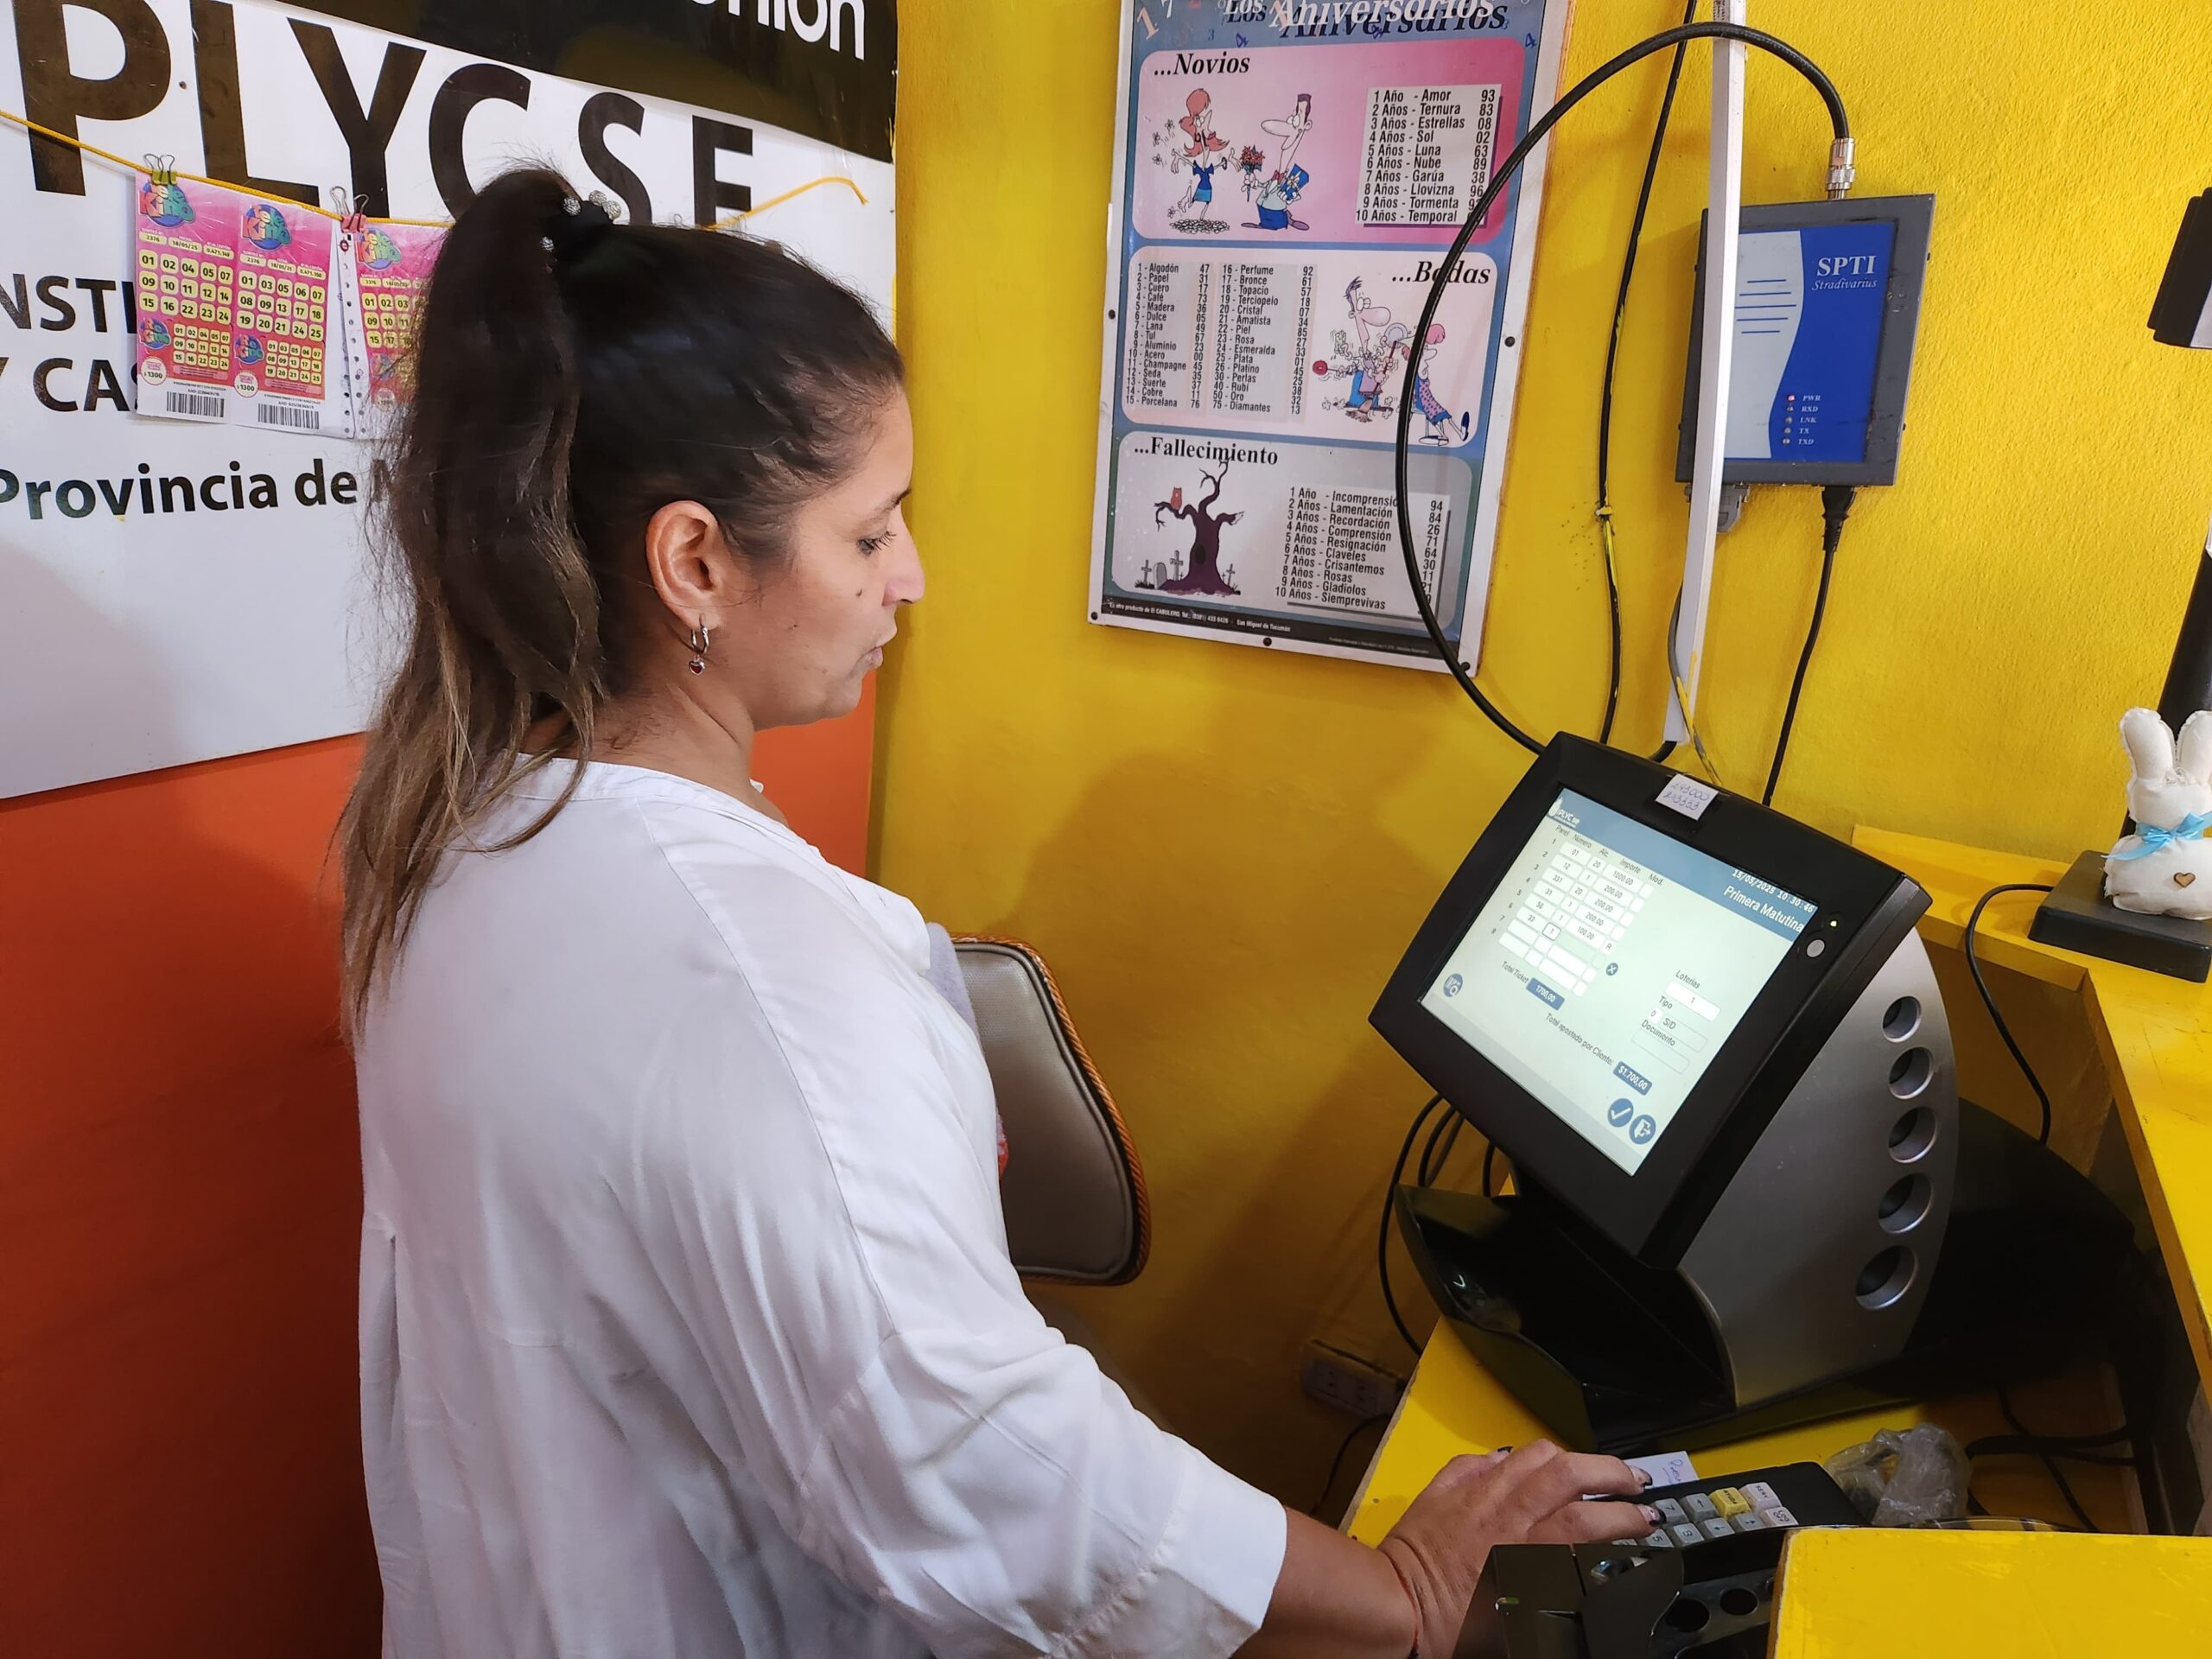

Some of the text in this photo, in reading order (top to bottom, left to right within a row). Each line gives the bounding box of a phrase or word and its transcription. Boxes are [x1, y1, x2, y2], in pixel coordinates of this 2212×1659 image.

[1268, 0, 1497, 29] Aniversarios
[1374, 89, 1495, 102] 1 Año Amor 93
[1372, 103, 1493, 116] 2 Años Ternura 83
[1371, 117, 1491, 130] 3 Años Estrellas 08
[1370, 130, 1490, 143] 4 Años Sol 02
[1369, 144, 1488, 157] 5 Años Luna 63
[1367, 156, 1487, 170] 6 Años Nube 89
[1367, 170, 1484, 183] 7 Años Garúa 38
[1364, 183, 1484, 197] 8 Años Llovizna 96
[1363, 196, 1459, 208] 9 Años Tormenta
[1357, 210, 1457, 225] 10 Años Temporal
[173, 240, 198, 250] 18/05/25
[142, 256, 231, 281] 01 02 04 05 07
[1149, 264, 1179, 274] Algodón
[1240, 265, 1274, 276] Perfume
[1816, 255, 1876, 276] SPTI
[1149, 274, 1169, 284] Papel
[1240, 275, 1268, 285] Bronce
[1812, 277, 1878, 291] Stradivarius
[142, 276, 229, 302] 09 10 11 12 14
[241, 276, 321, 300] 01 03 05 06 07
[1148, 284, 1169, 293] Cuero
[1239, 284, 1268, 296] Topacio
[1147, 293, 1164, 302] Café
[1238, 295, 1278, 307] Terciopelo
[143, 297, 229, 321] 15 16 22 23 24
[240, 296, 321, 319] 08 09 13 17 18
[1147, 302, 1174, 312] Madera
[239, 315, 321, 339] 19 20 21 24 25
[1234, 346, 1275, 356] Esmeralda
[1143, 359, 1186, 371] Champagne
[1141, 397, 1177, 408] Porcelana
[1230, 403, 1270, 413] Diamantes
[0, 461, 278, 520] Provincia
[294, 458, 358, 506] de
[1331, 502, 1441, 524] Lamentación 84
[1430, 500, 1442, 512] 94
[1330, 513, 1440, 535] Recordación 26
[1328, 525, 1438, 546] Comprensión 71
[1327, 537, 1437, 558] Resignación 64
[1326, 548, 1435, 570] Claveles 30
[1325, 559, 1384, 575] Crisantemos
[1324, 570, 1352, 583] Rosas
[1323, 582, 1366, 596] Gladiolos
[1321, 593, 1385, 610] Siemprevivas
[1620, 858, 1641, 874] Importe
[1732, 869, 1815, 912] 15/05/2025 10:30:46
[1723, 886, 1804, 933] Primera Matutina
[1659, 995, 1673, 1009] Tipo
[1641, 1020, 1675, 1046] Documento
[1582, 1039, 1593, 1052] por
